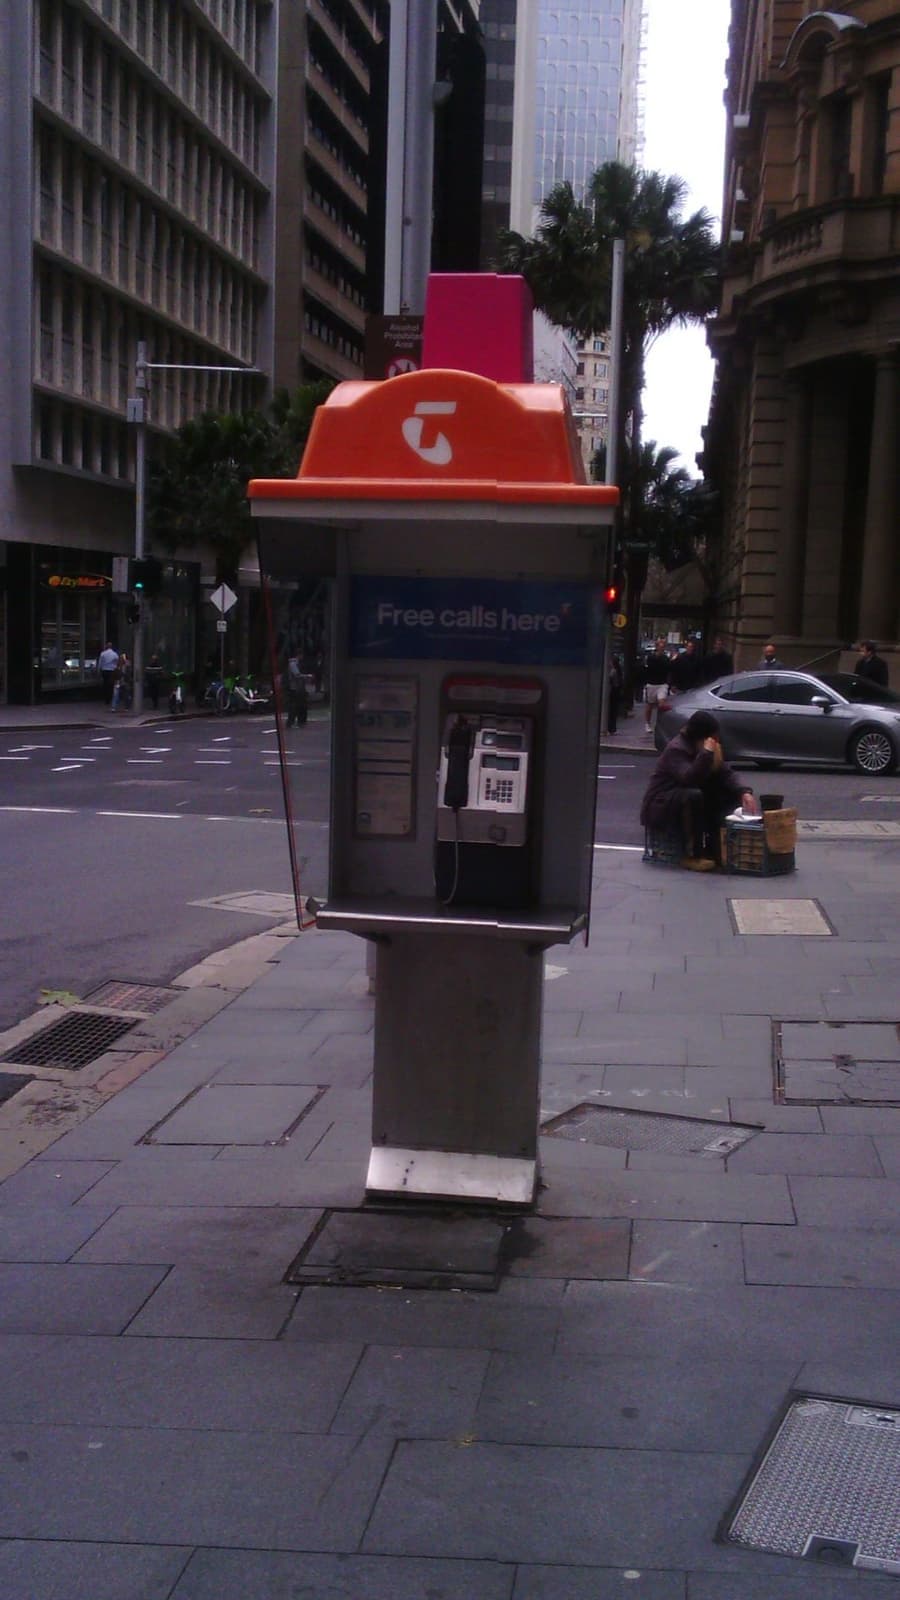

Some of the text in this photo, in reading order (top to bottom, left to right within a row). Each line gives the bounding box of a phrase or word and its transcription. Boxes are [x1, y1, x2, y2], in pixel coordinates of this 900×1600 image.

[377, 603, 560, 632] Free calls here
